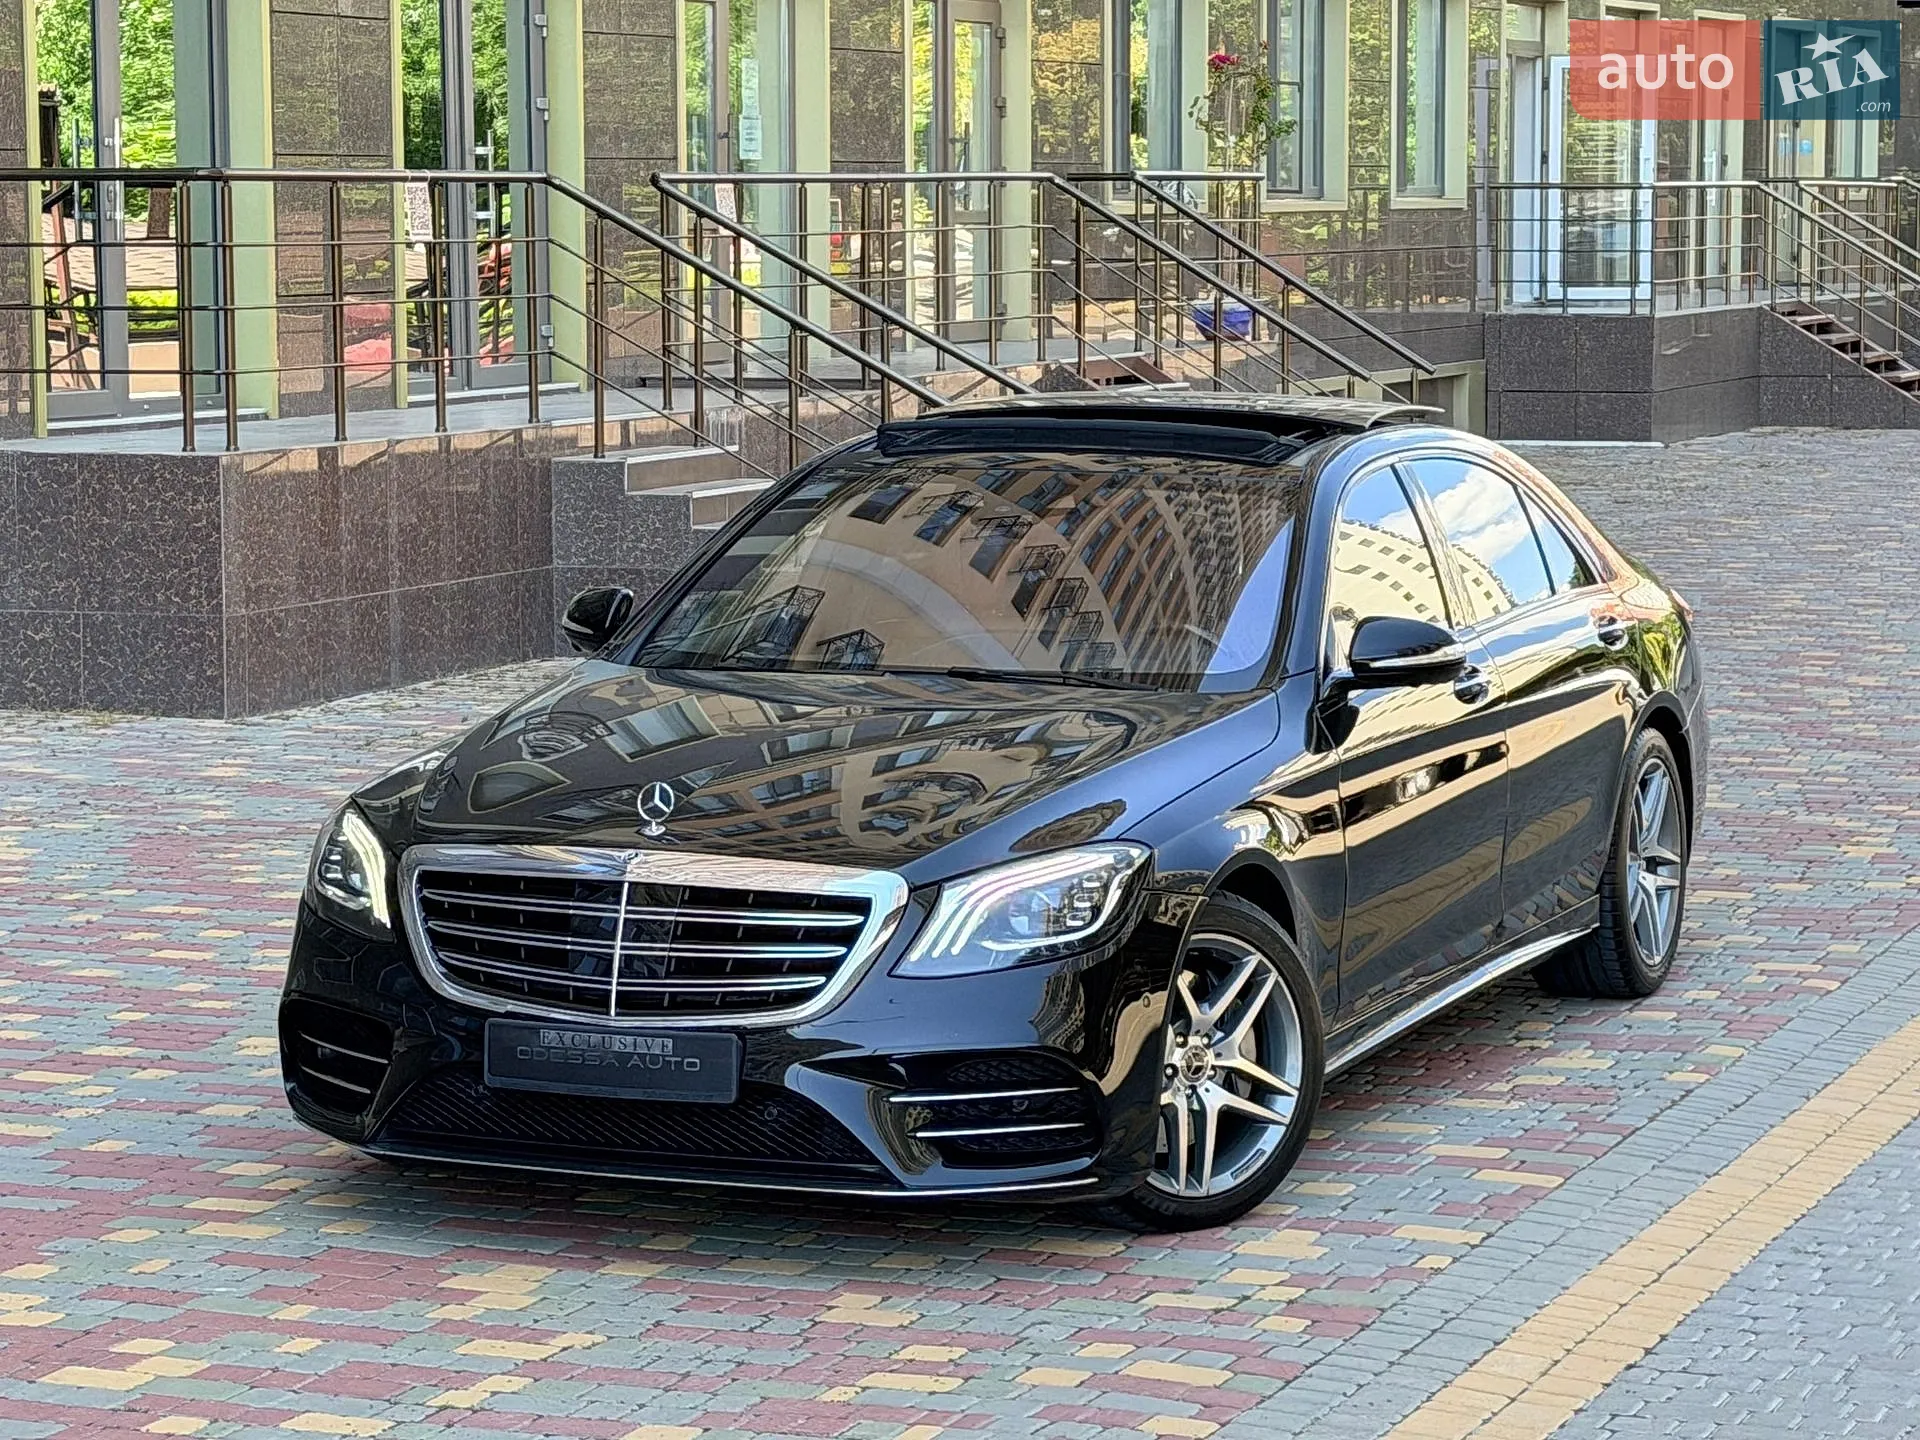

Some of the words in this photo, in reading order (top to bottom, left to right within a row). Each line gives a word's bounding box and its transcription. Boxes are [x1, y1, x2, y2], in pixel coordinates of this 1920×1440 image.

[540, 1030, 672, 1054] EXCLUSIVE
[517, 1046, 619, 1067] ODESSA
[626, 1055, 701, 1071] AUTO
